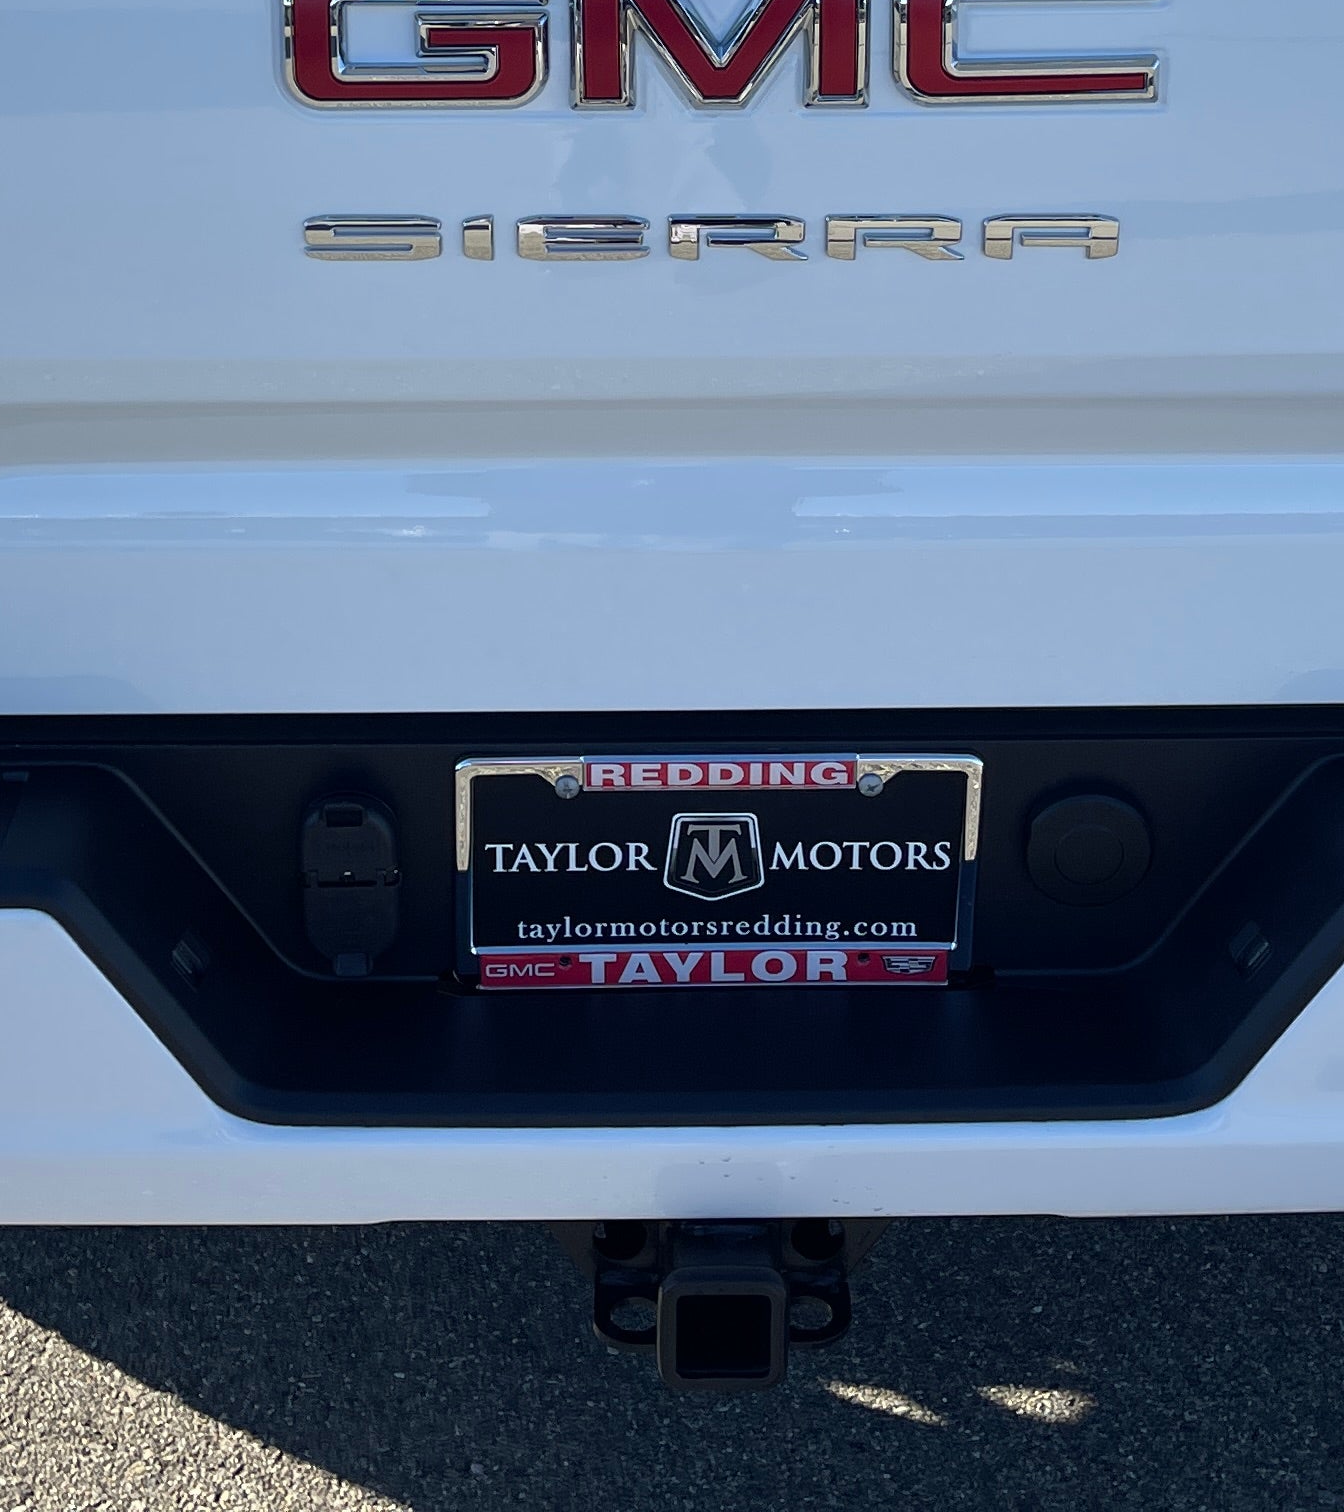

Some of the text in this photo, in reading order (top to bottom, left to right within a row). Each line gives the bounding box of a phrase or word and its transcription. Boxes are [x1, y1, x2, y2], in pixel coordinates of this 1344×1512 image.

[303, 213, 1120, 262] SIERRA
[590, 763, 849, 786] REDDING
[485, 840, 951, 872] TAYLOR MOTORS
[517, 914, 918, 941] taylormotorsredding.com
[485, 951, 848, 983] GMC TAYLOR
